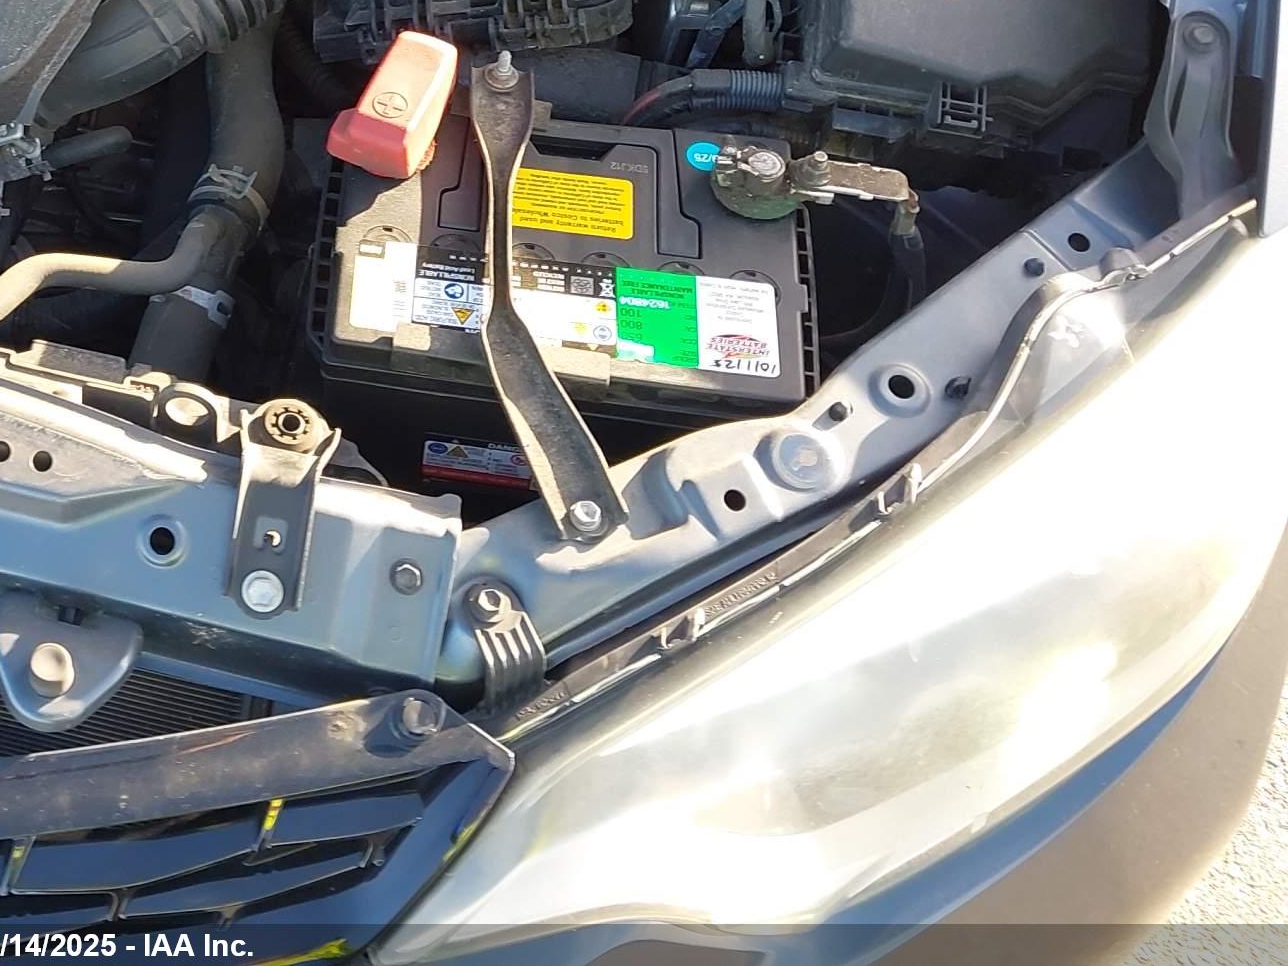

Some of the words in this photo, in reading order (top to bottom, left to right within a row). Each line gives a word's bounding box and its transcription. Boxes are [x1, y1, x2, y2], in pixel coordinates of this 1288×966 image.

[551, 212, 578, 222] Costco
[620, 307, 642, 318] 100
[620, 319, 643, 330] 800
[711, 336, 768, 349] BATTERIES
[705, 343, 770, 357] INTERSTATE
